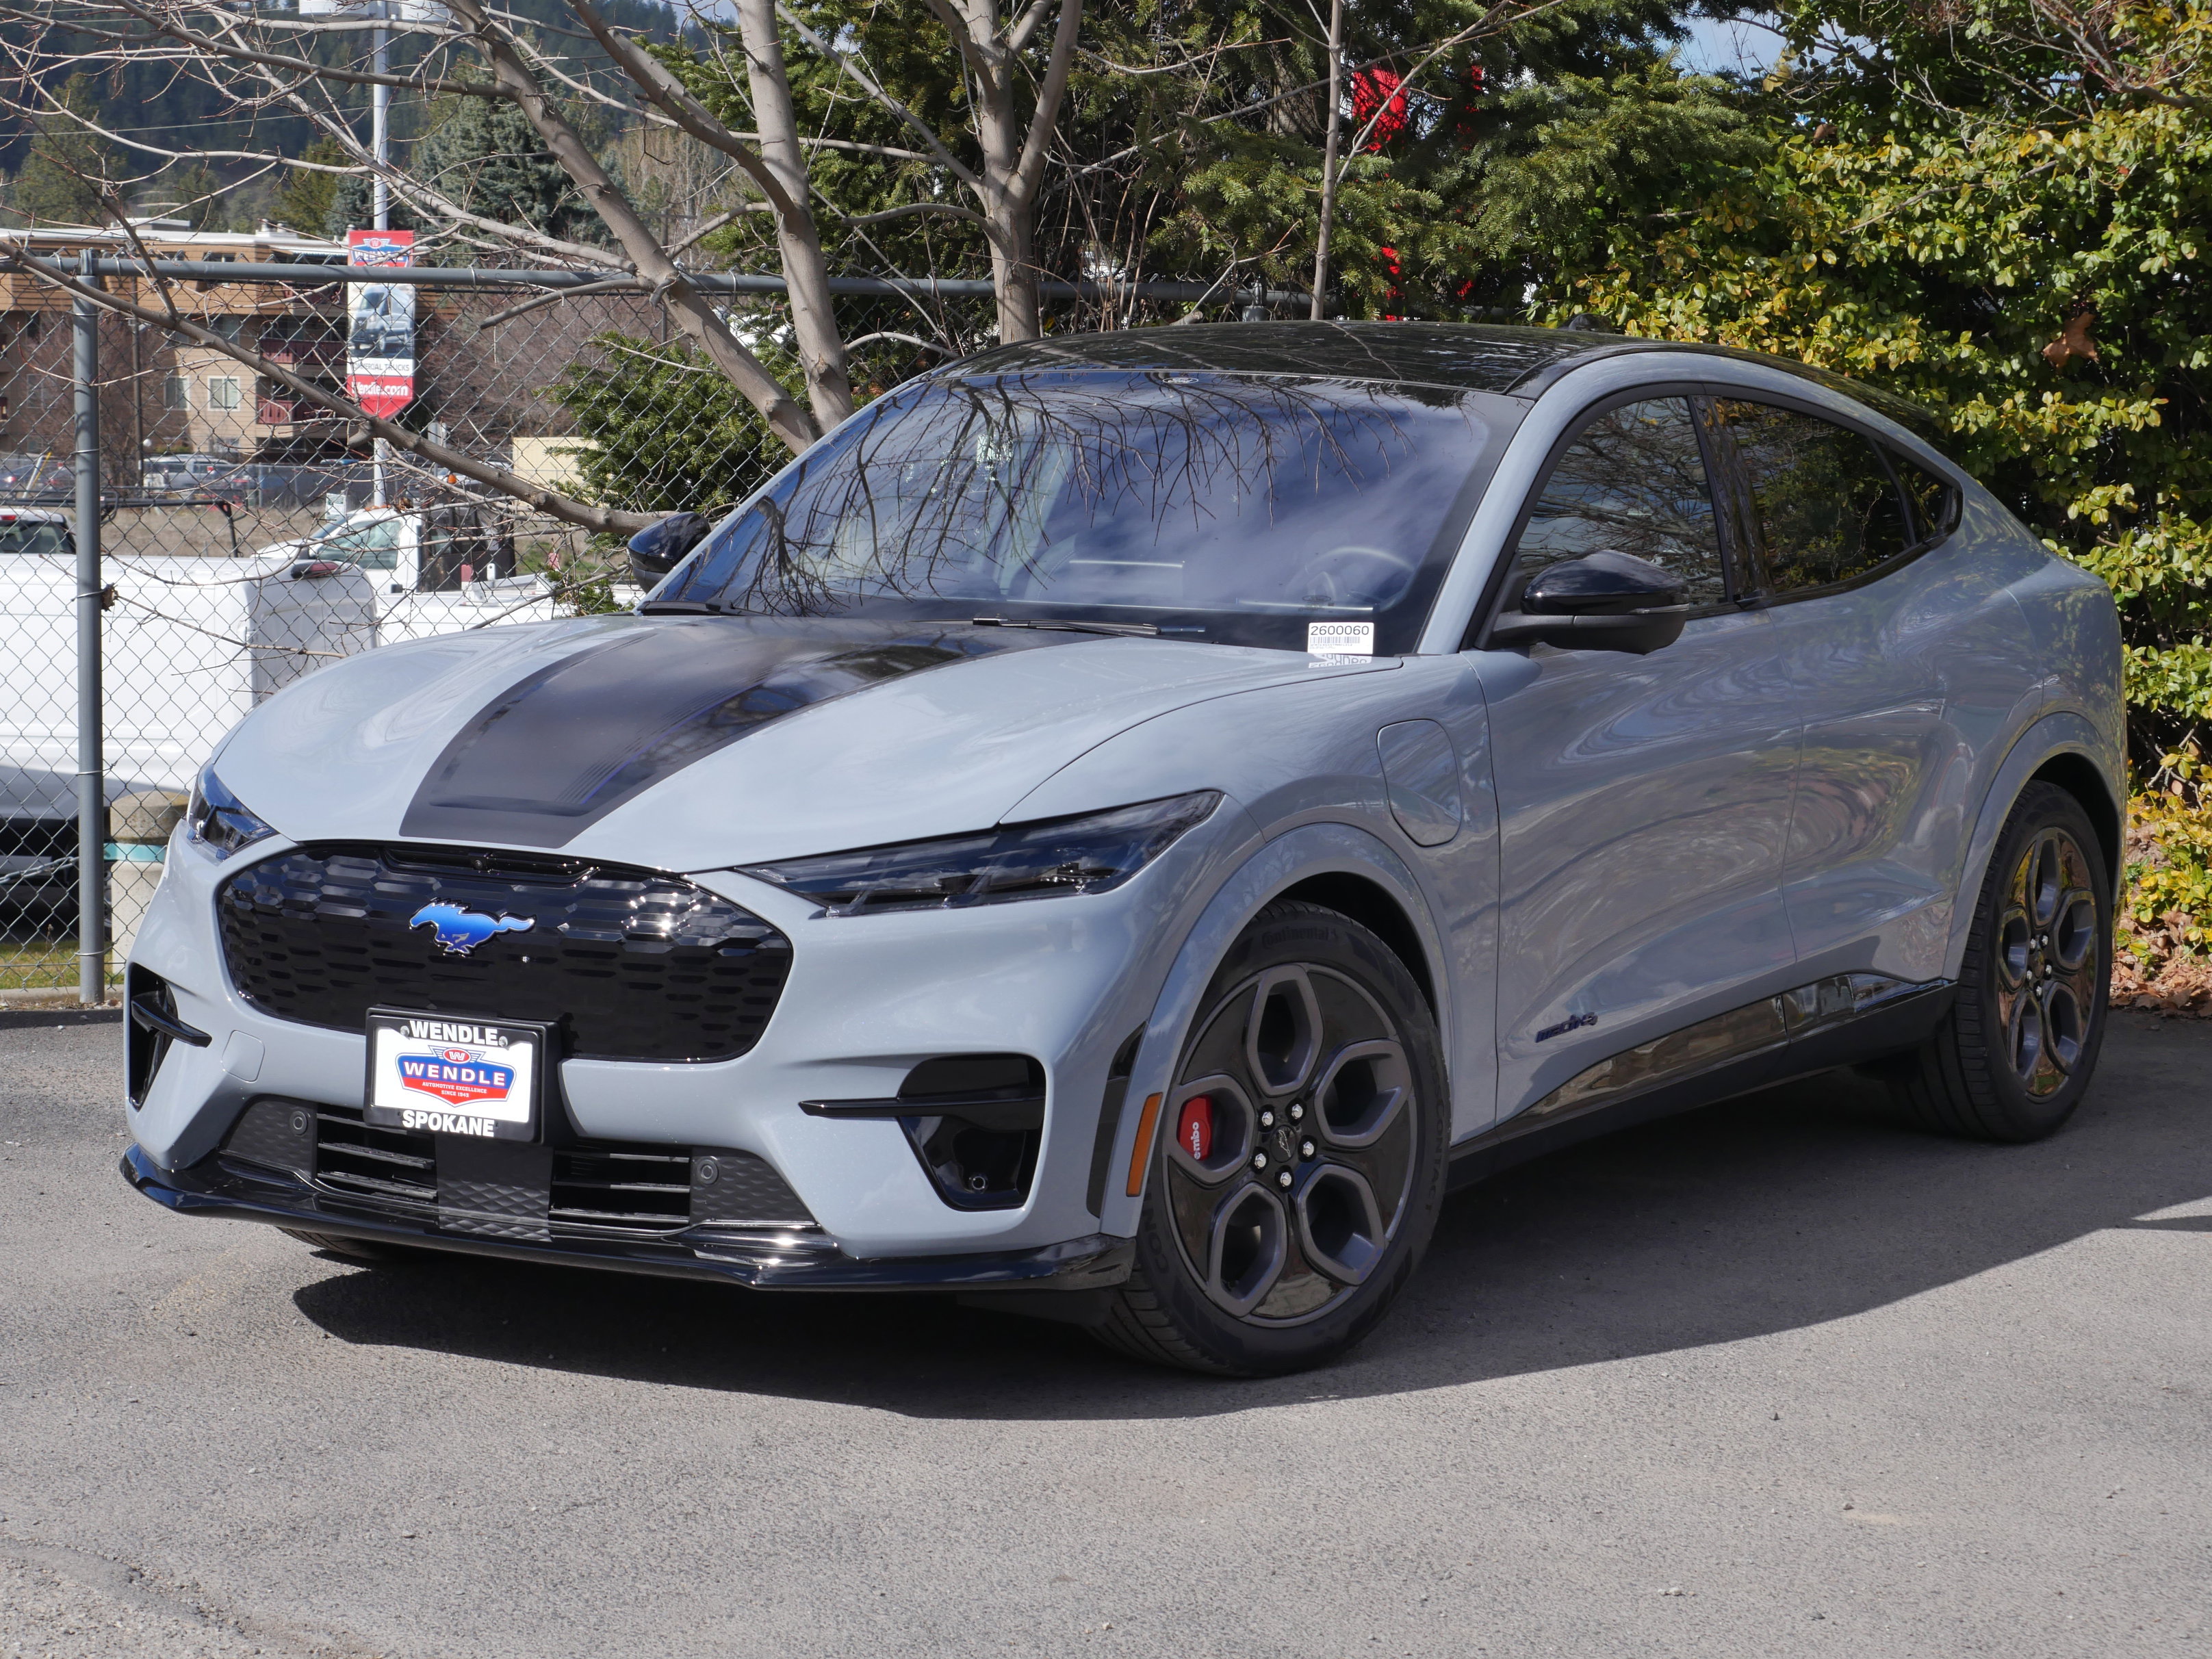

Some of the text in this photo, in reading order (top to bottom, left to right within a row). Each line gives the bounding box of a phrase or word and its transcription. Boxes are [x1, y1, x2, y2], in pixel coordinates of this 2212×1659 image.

[351, 381, 409, 396] Wendle.com
[1311, 626, 1369, 636] 2600060
[1261, 925, 1329, 950] Continental
[409, 1020, 498, 1046] WENDLE
[404, 1062, 505, 1086] WENDLE
[422, 1081, 487, 1094] AUTOMOTIVE EXCELLENCE
[402, 1109, 495, 1137] SPOKANE
[1424, 1033, 1445, 1216] ROSSCONTACT
[1190, 1121, 1201, 1160] embo
